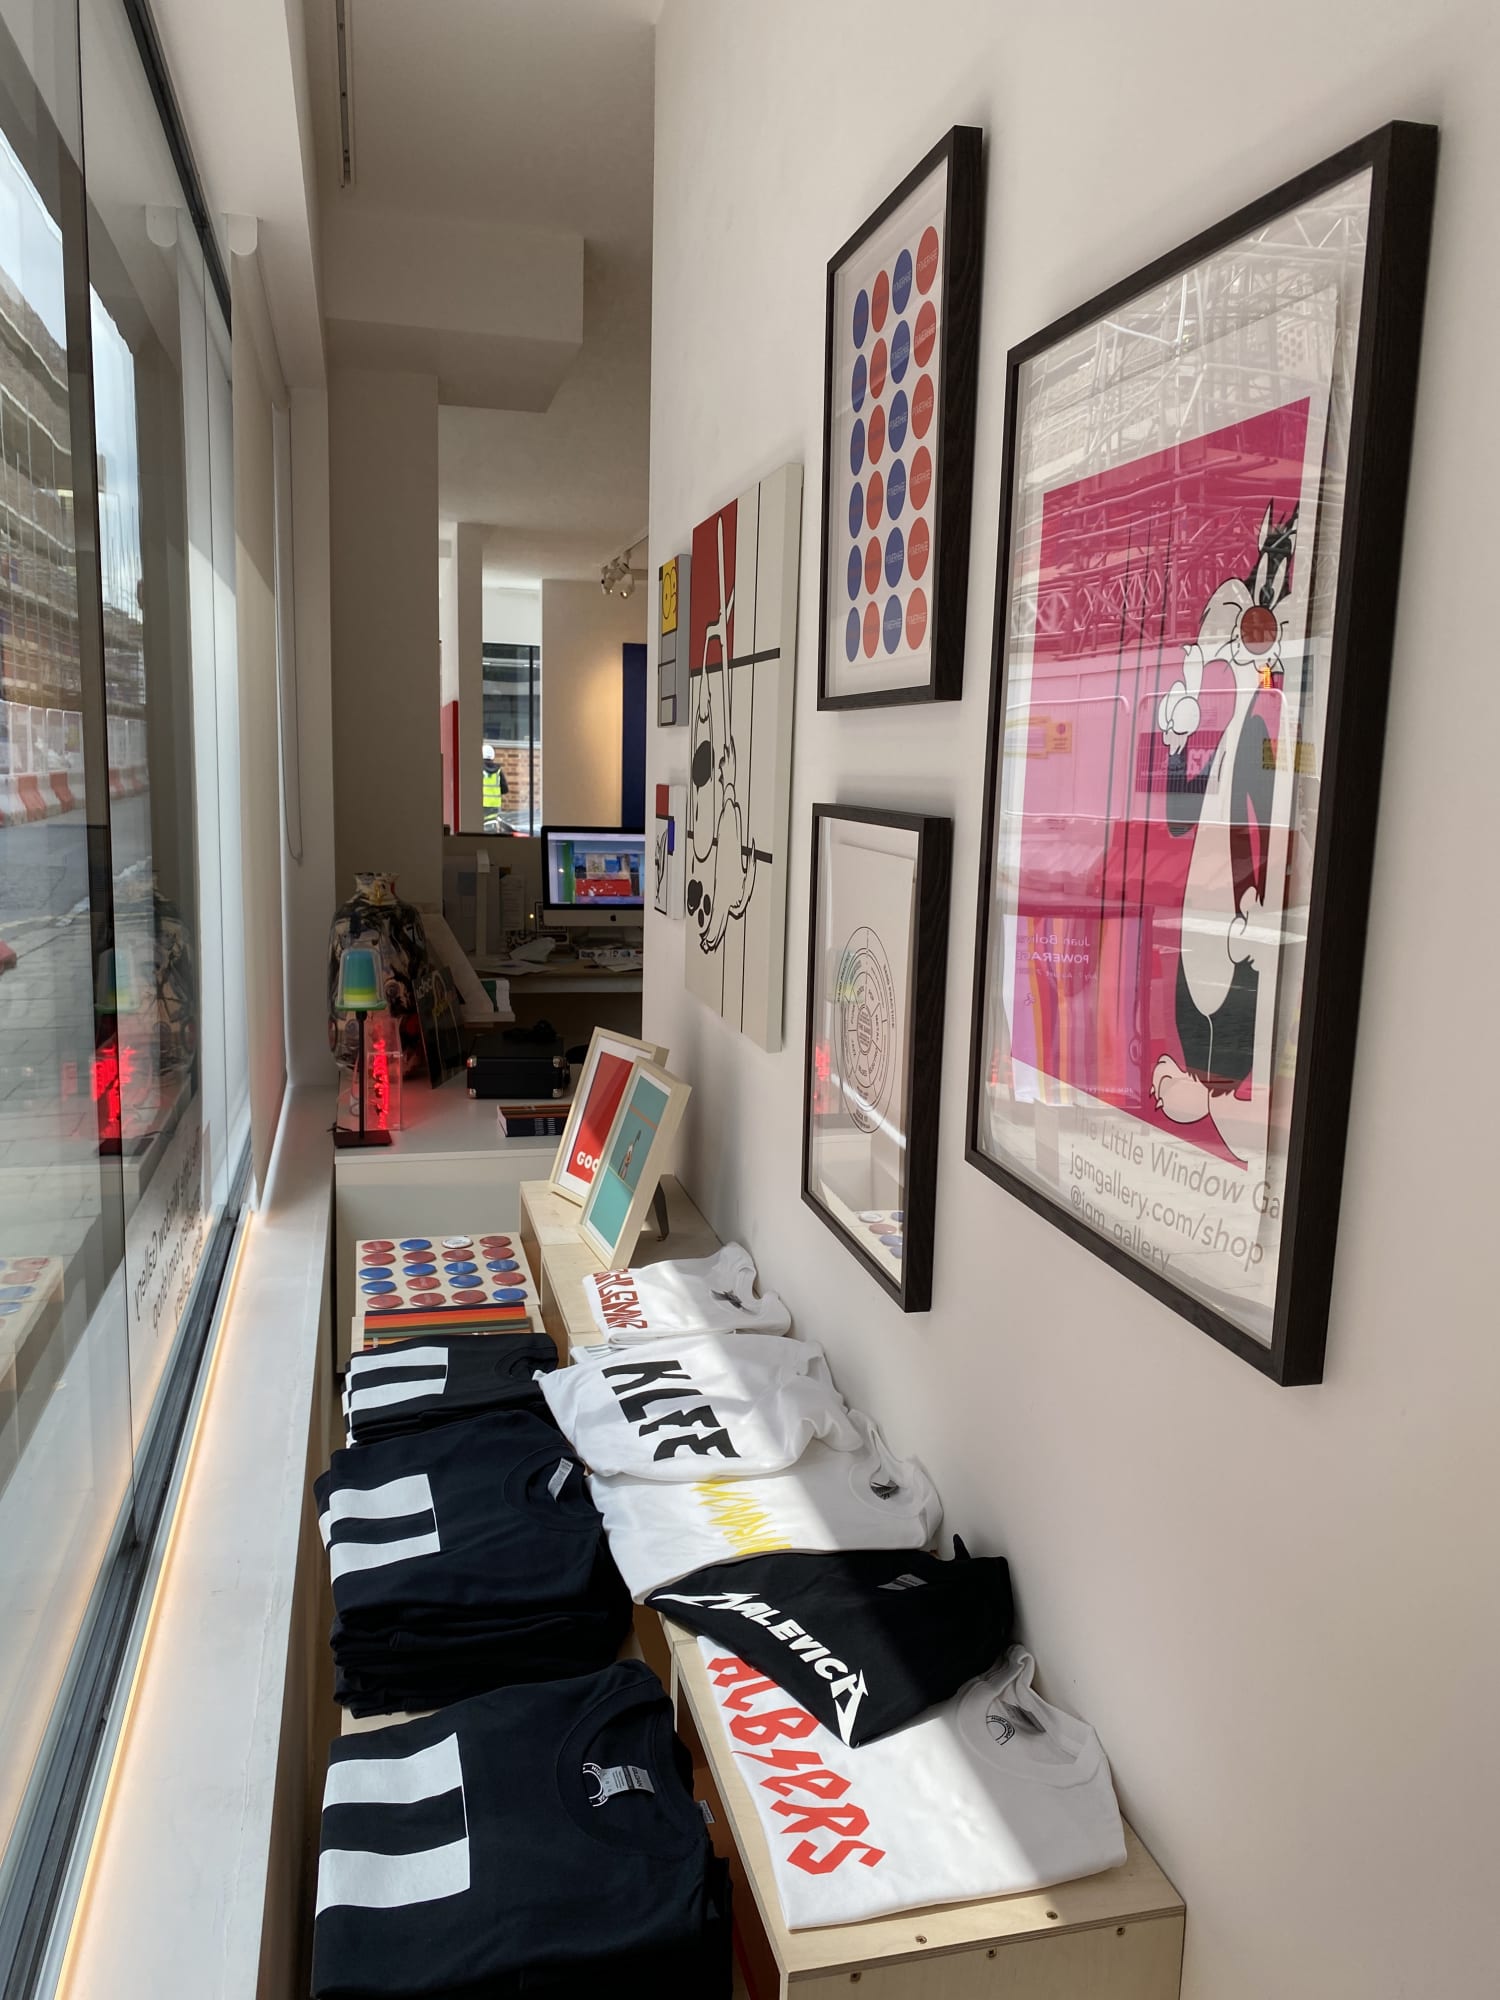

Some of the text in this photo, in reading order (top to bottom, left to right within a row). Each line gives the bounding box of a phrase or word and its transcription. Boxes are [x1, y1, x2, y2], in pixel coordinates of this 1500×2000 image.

[1070, 1143, 1264, 1273] jgmgallery.com/shop
[1101, 1120, 1144, 1165] Little
[1151, 1142, 1245, 1203] Window
[602, 1360, 742, 1462] KLEE
